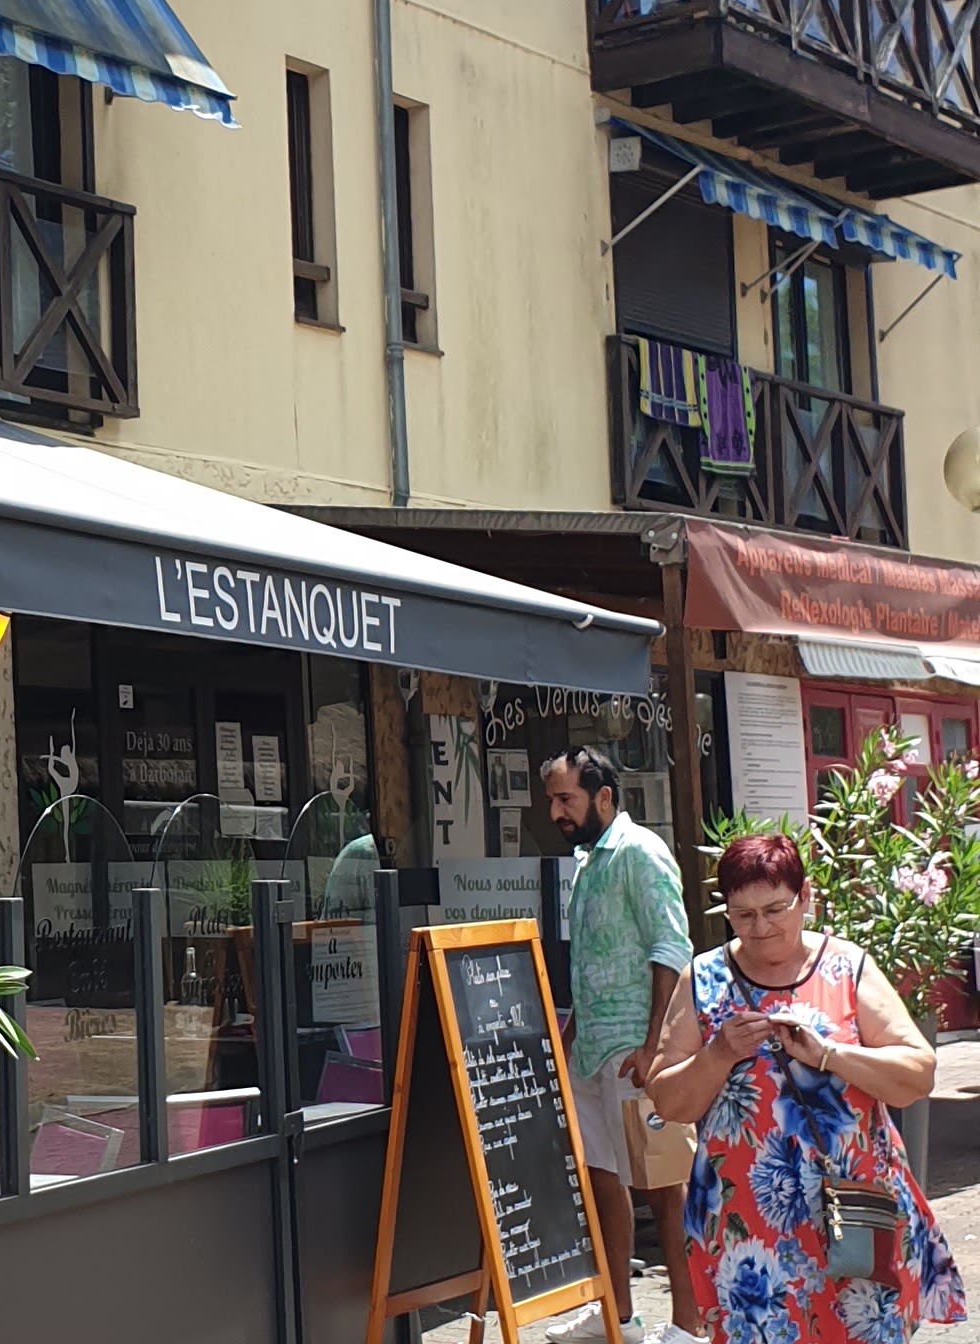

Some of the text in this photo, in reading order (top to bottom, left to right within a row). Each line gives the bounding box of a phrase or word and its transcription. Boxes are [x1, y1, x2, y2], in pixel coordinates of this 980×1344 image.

[154, 555, 402, 655] L'ESTANQUET
[156, 733, 171, 752] 30
[172, 736, 193, 753] ans
[453, 873, 492, 892] Nous
[444, 908, 467, 921] vos
[470, 903, 534, 920] douleurs
